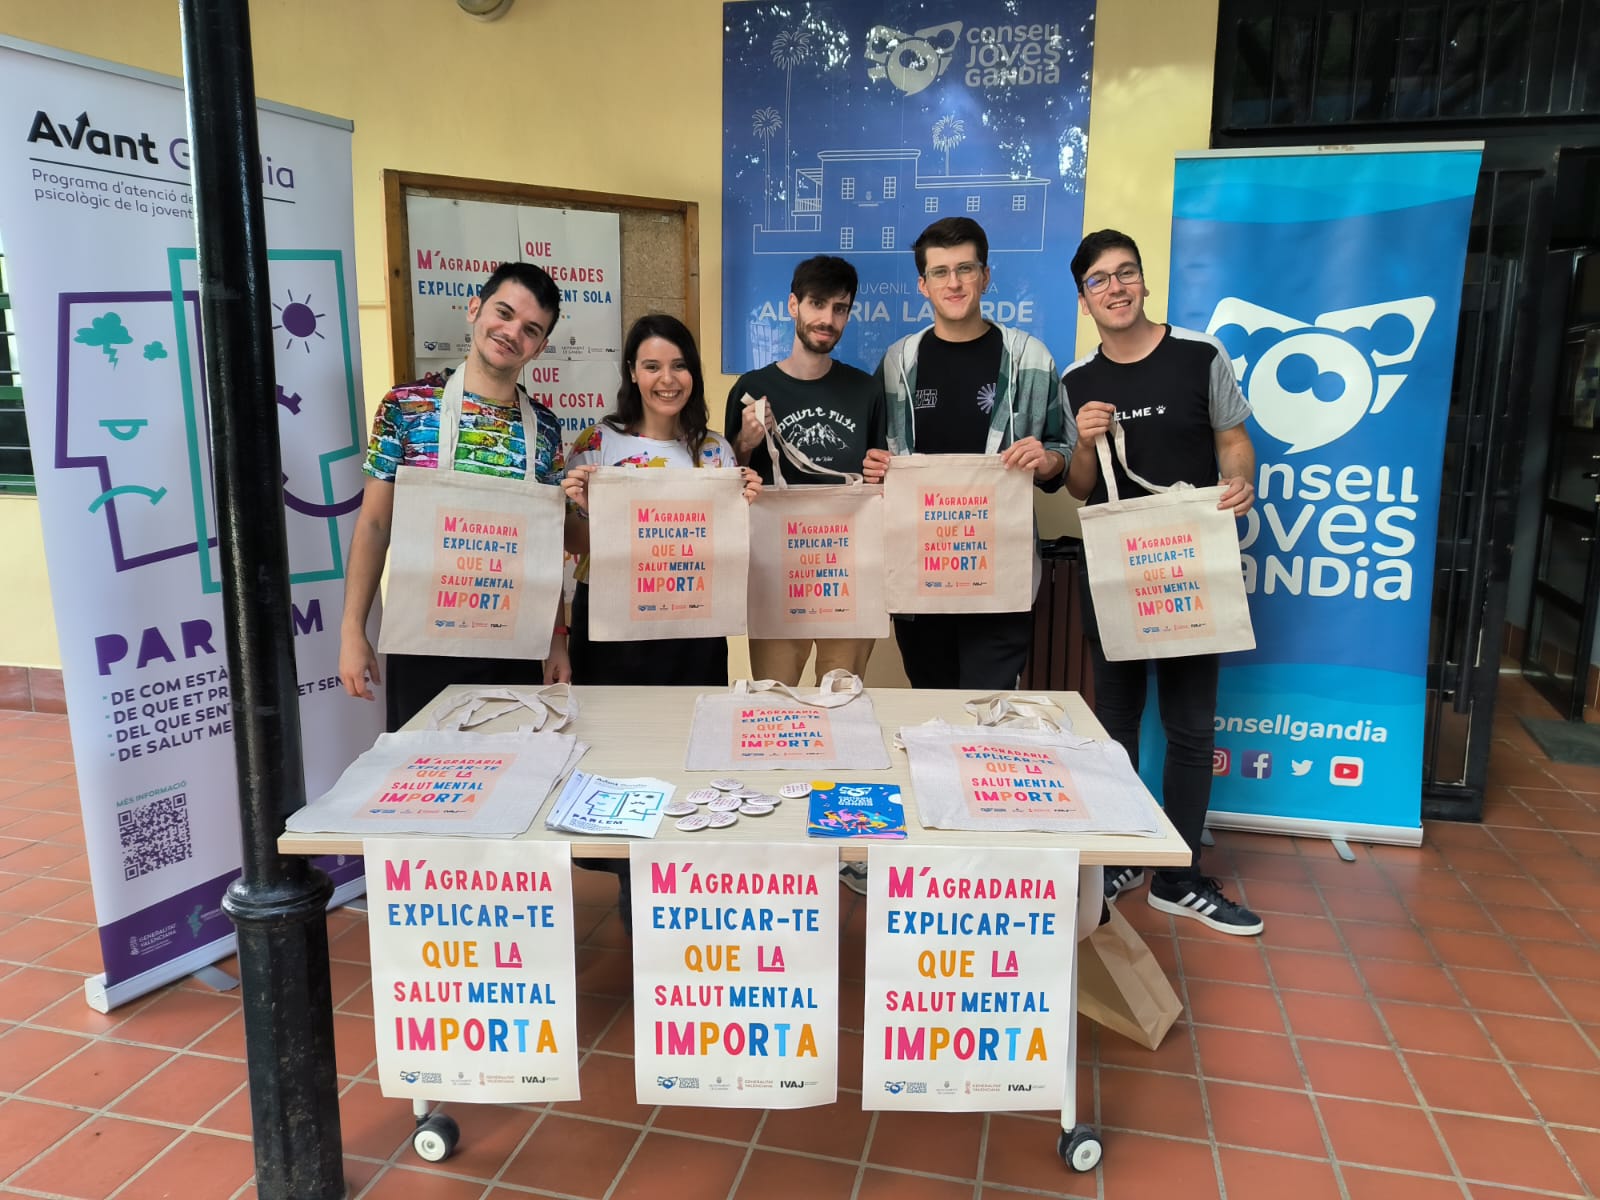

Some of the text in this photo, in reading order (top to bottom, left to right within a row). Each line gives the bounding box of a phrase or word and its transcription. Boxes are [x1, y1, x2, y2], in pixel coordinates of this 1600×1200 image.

[27, 110, 159, 165] Avant
[32, 168, 107, 192] Programa
[112, 181, 177, 203] d'atenció
[35, 188, 111, 209] psicològic
[115, 200, 132, 211] de
[136, 203, 148, 213] la
[525, 241, 552, 257] QUE
[583, 290, 612, 303] SOLA
[903, 301, 1034, 322] LARDE
[532, 367, 560, 383] QUE
[559, 392, 605, 408] COSTA
[1112, 406, 1152, 422] ELME
[925, 509, 989, 521] EXPLICAR-TE
[638, 527, 707, 539] EXPLICAR-TE
[936, 525, 976, 537] QUE LA
[443, 537, 518, 554] EXPLICAR-TE
[652, 544, 694, 557] QUE LA
[788, 537, 849, 549] EXPLICAR-TE
[925, 541, 988, 552] SALUT MENTAL
[457, 556, 503, 573] QUE LA
[800, 552, 837, 565] QUE LA
[924, 554, 988, 571] IMPORTA
[1129, 548, 1195, 566] EXPLICAR-TE
[638, 561, 706, 572] SALUT MENTAL
[789, 568, 849, 579] SALUT MENTAL
[1143, 565, 1183, 581] QUE LA
[440, 575, 514, 589] SALUT MENTAL
[637, 575, 705, 593] IMPORTA
[789, 582, 849, 598] IMPORTA
[1135, 581, 1200, 596] SALUT MENTAL
[437, 590, 511, 611] IMPORTA
[1137, 596, 1204, 616] IMPORTA
[95, 598, 324, 676] PARM
[111, 665, 229, 705] DE COM ESTÀ
[114, 707, 137, 725] DE
[142, 698, 179, 718] QUE
[183, 691, 203, 707] ET
[116, 725, 150, 743] DEL
[155, 713, 191, 733] QUE
[791, 722, 806, 730] LA
[118, 744, 142, 762] DE
[147, 728, 204, 754] SALUT
[741, 739, 825, 748] IMPORTA
[415, 770, 473, 778] QUE LA
[986, 762, 1042, 774] QUE LA
[391, 782, 484, 790] SALUT MENTAL
[971, 777, 1064, 788] SALUT MENTAL
[378, 792, 477, 803] IMPORTA
[974, 790, 1071, 802] IMPORTA
[387, 903, 555, 928] EXPLICAR-TE
[652, 906, 820, 932] EXPLICAR-TE
[887, 910, 1056, 936] EXPLICAR-TE
[422, 940, 523, 969] QUE LA
[684, 944, 785, 973] QUE LA
[917, 950, 1019, 979] QUE LA
[393, 981, 556, 1005] SALUT MENTAL
[654, 984, 818, 1009] SALUT MENTAL
[886, 990, 1050, 1013] SALUT MENTAL
[395, 1017, 558, 1054] IMPORTA
[655, 1021, 819, 1058] IMPORTA
[884, 1026, 1048, 1061] IMPORTA
[780, 1080, 804, 1089] IVAJ
[1008, 1084, 1032, 1092] IVAJ
